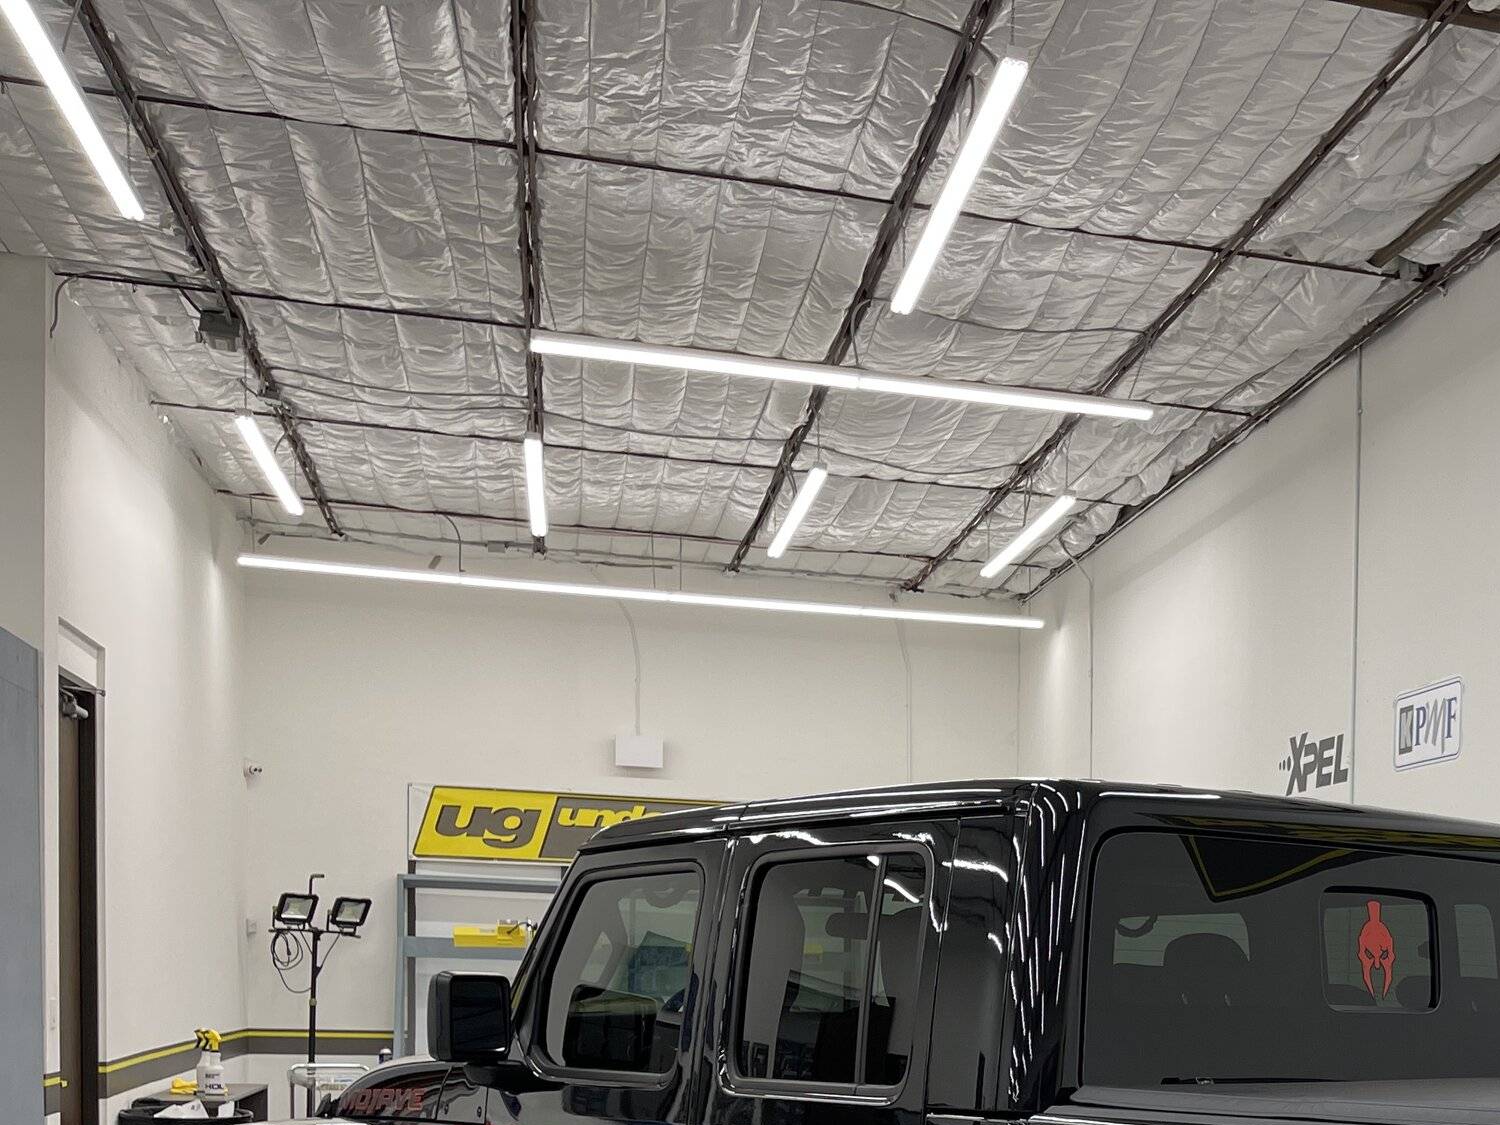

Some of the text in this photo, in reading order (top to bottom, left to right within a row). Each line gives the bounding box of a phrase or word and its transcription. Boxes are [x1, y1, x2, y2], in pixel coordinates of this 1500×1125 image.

[1399, 697, 1458, 755] KPMF
[1286, 732, 1349, 796] XPEL
[435, 805, 542, 849] ug
